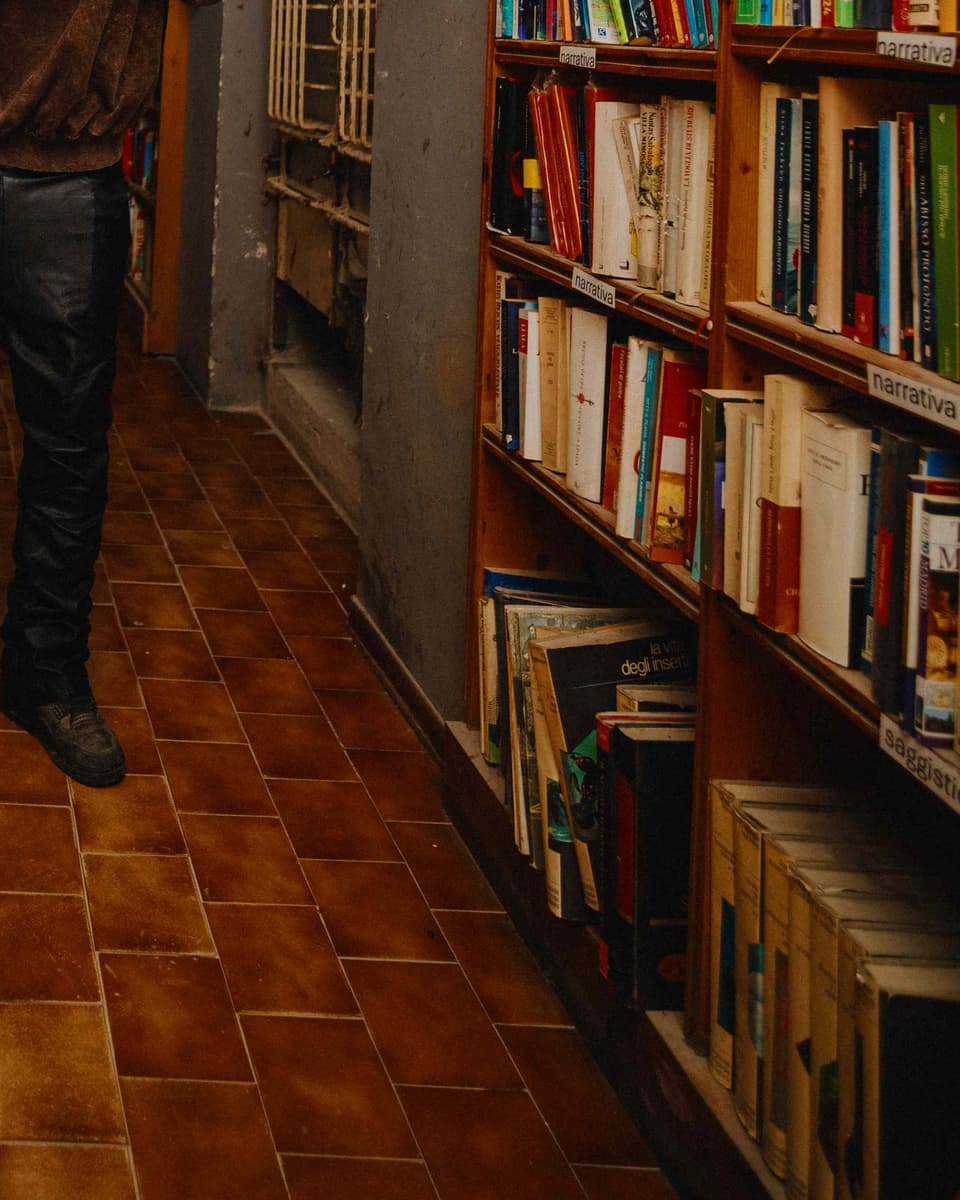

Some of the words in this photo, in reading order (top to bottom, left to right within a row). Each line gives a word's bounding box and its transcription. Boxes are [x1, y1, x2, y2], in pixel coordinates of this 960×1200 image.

[560, 50, 595, 68] narrativa
[878, 34, 955, 66] narrativa
[575, 274, 614, 307] narrativa
[921, 248, 931, 332] PROFONDO
[872, 369, 958, 420] narrativa
[919, 556, 930, 610] MADRID
[649, 640, 662, 654] la
[621, 655, 651, 676] degli
